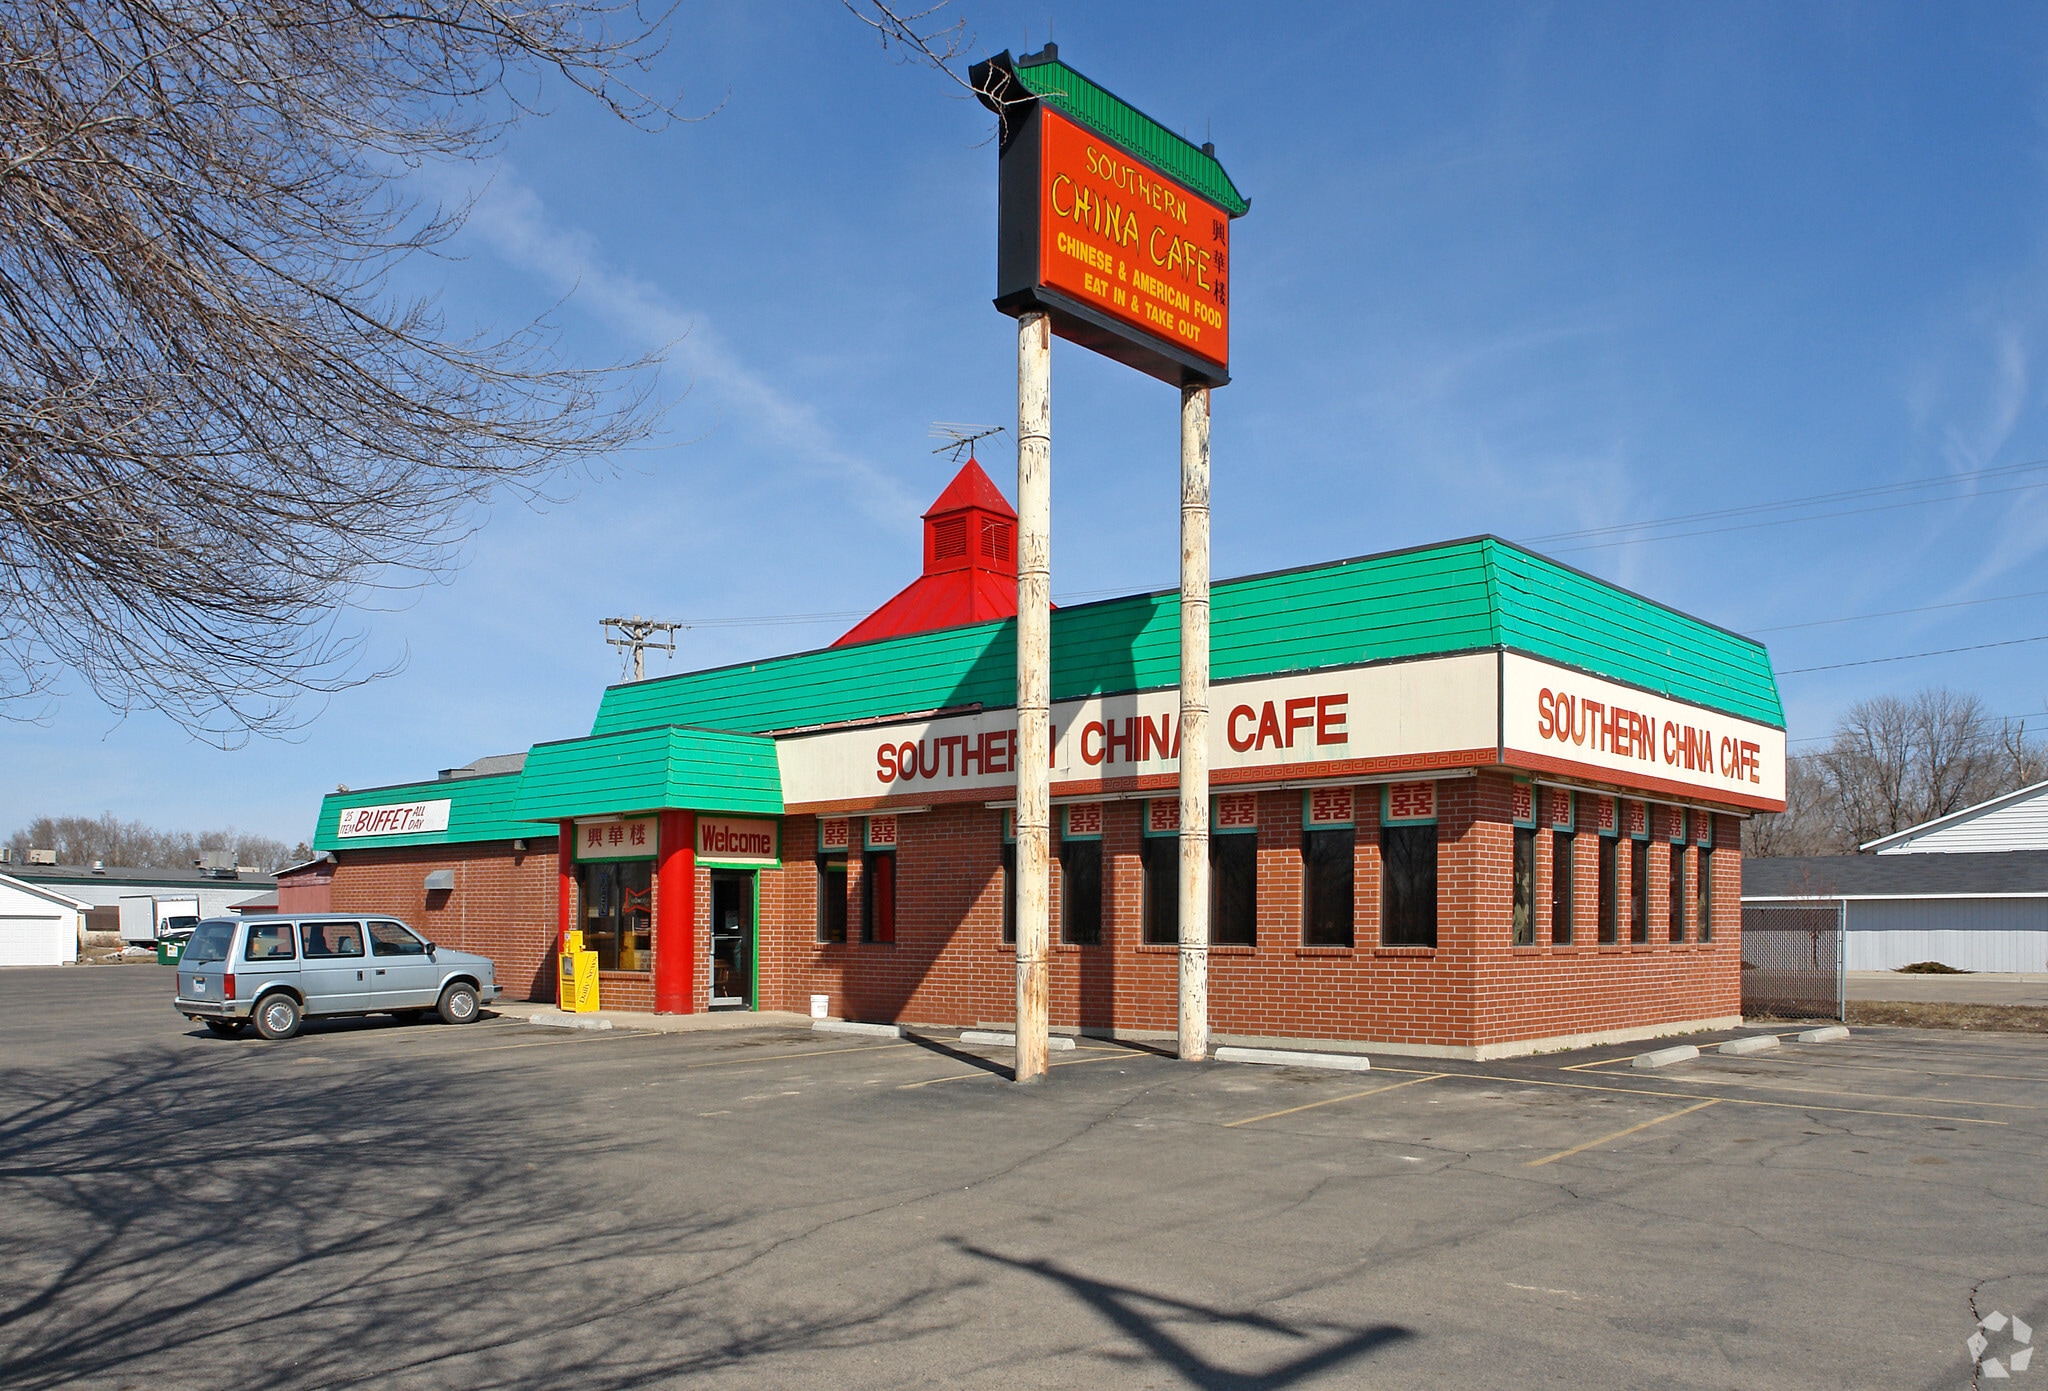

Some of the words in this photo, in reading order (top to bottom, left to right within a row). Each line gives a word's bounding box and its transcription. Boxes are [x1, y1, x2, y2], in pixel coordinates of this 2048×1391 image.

[1086, 145, 1188, 225] SOUTHERN
[1051, 173, 1139, 256] CHINA
[1150, 226, 1211, 291] CAFE
[1057, 231, 1113, 275] CHINESE
[1118, 261, 1127, 282] &
[1133, 269, 1190, 314] AMERICAN
[1194, 300, 1222, 330] FOOD
[1084, 272, 1108, 297] EAT
[1114, 286, 1126, 307] IN
[1131, 295, 1139, 314] &
[1145, 302, 1174, 330] TAKE
[1178, 319, 1201, 342] OUT
[877, 725, 1056, 783] SOUTHE
[1081, 713, 1180, 766] CHIN
[1227, 693, 1349, 753] CAFE
[1538, 687, 1655, 762] SOUTHERN
[1663, 720, 1714, 773] CHINA
[1721, 736, 1760, 784] CAFE
[354, 808, 413, 833] BUFFET
[408, 819, 424, 830] DAY
[412, 806, 425, 816] ALL
[702, 824, 771, 854] Welcome
[580, 983, 590, 1004] Daily
[586, 956, 598, 979] News
